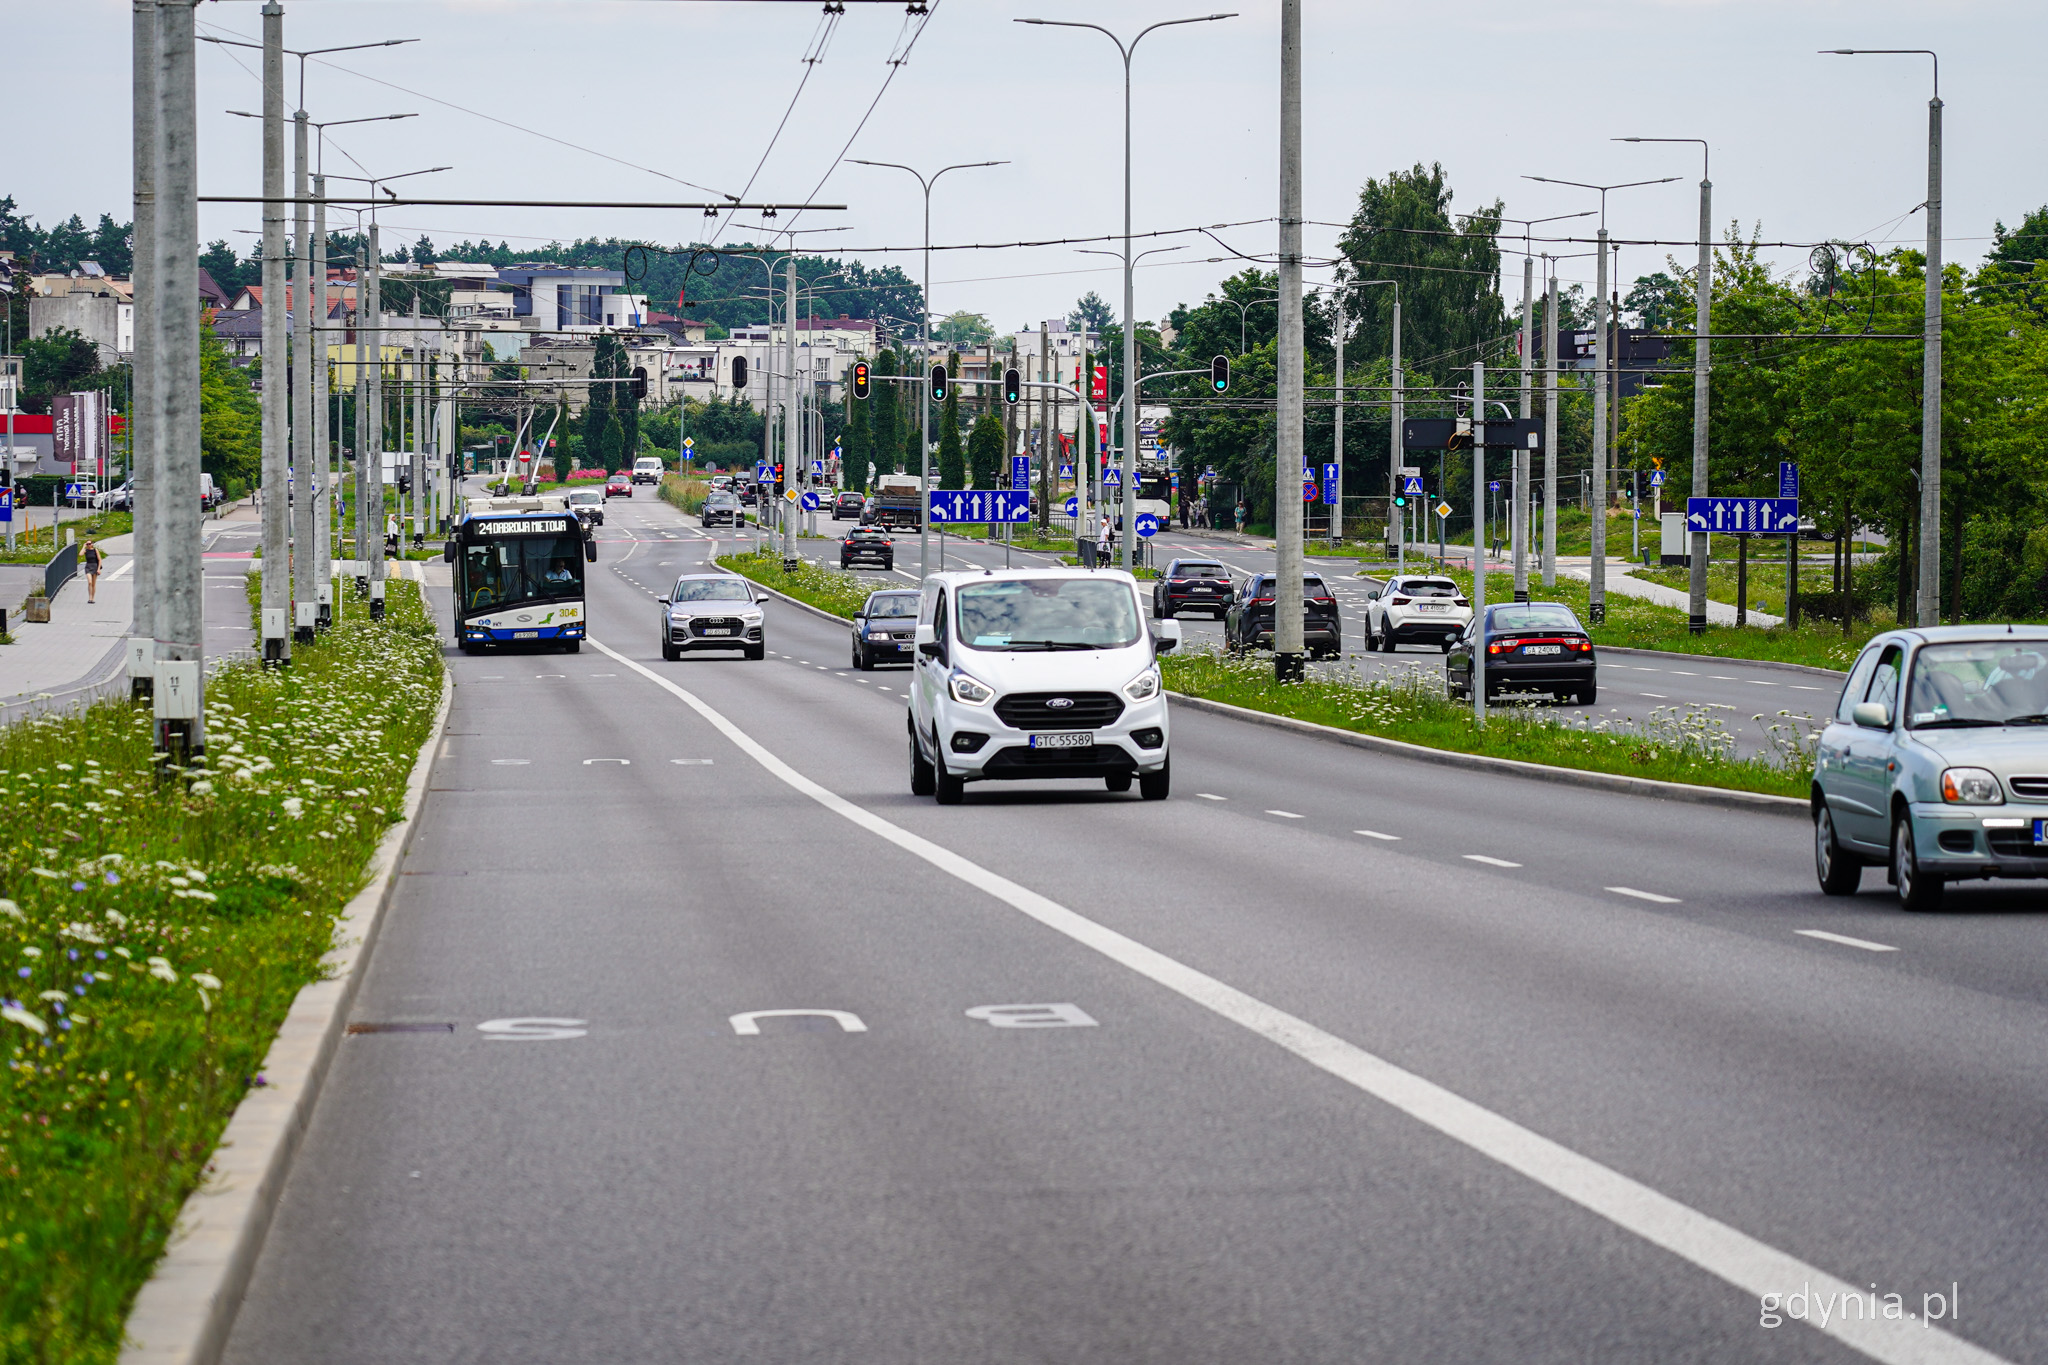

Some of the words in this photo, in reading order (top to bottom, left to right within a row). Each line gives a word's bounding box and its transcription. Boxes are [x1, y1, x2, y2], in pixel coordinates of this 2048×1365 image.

[479, 522, 492, 535] 24
[559, 608, 578, 618] 3046
[170, 676, 179, 685] 11
[1035, 735, 1056, 747] GTC
[1059, 734, 1091, 746] 55589
